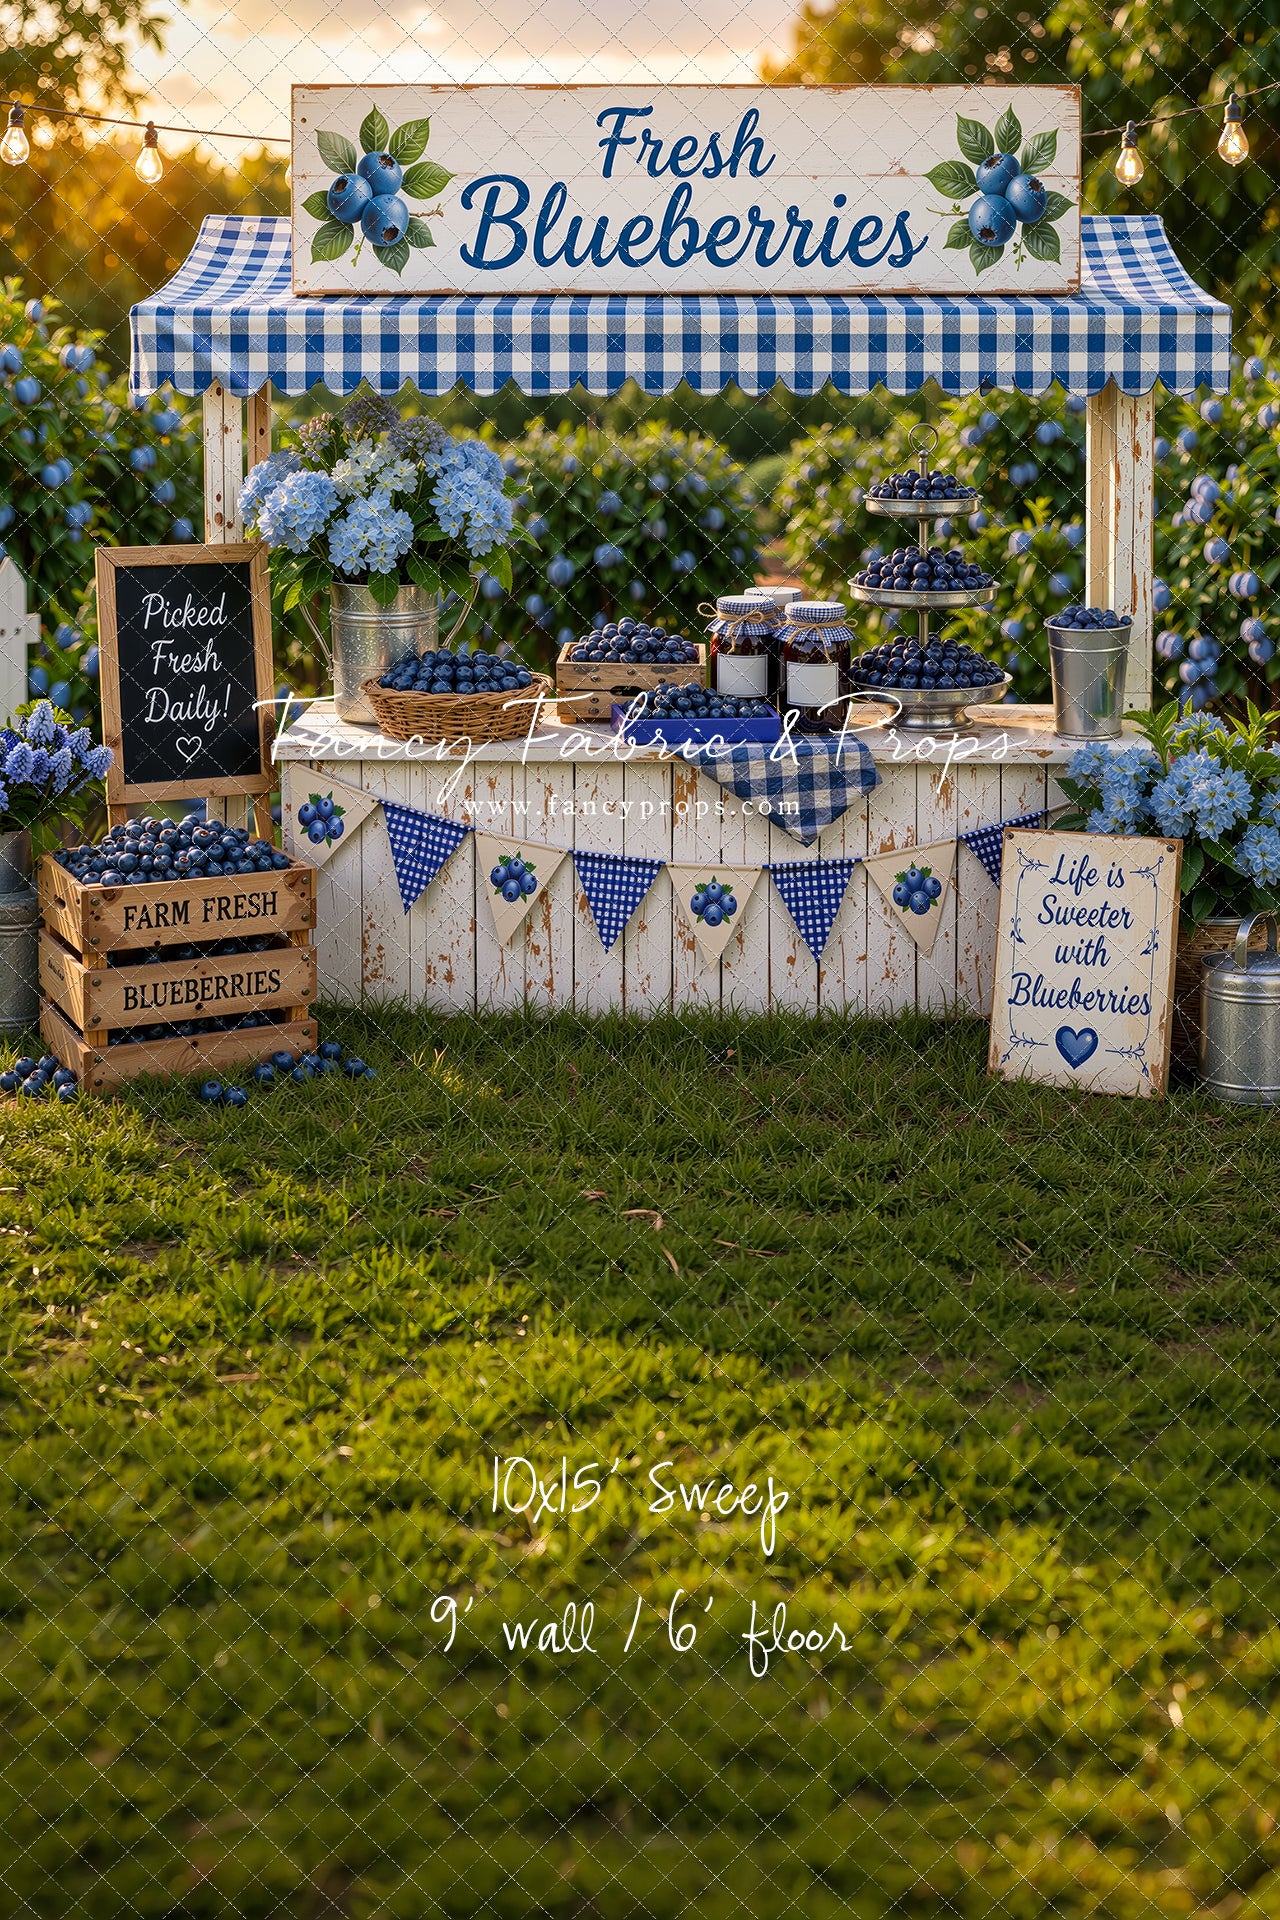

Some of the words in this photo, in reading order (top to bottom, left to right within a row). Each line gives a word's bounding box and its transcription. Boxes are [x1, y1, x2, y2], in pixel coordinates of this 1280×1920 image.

[596, 106, 775, 178] Fresh
[459, 173, 928, 271] Blueberries
[141, 592, 227, 630] Picked
[151, 638, 222, 675] Fresh
[144, 683, 231, 732] Daily!
[1049, 854, 1099, 896] Life
[1107, 861, 1125, 889] is
[123, 900, 190, 931] FARM
[202, 891, 278, 922] FRESH
[1037, 894, 1135, 930] Sweeter
[1055, 935, 1111, 967] with
[123, 968, 281, 1011] BLUEBERRIES
[1007, 972, 1152, 1016] Blueberries
